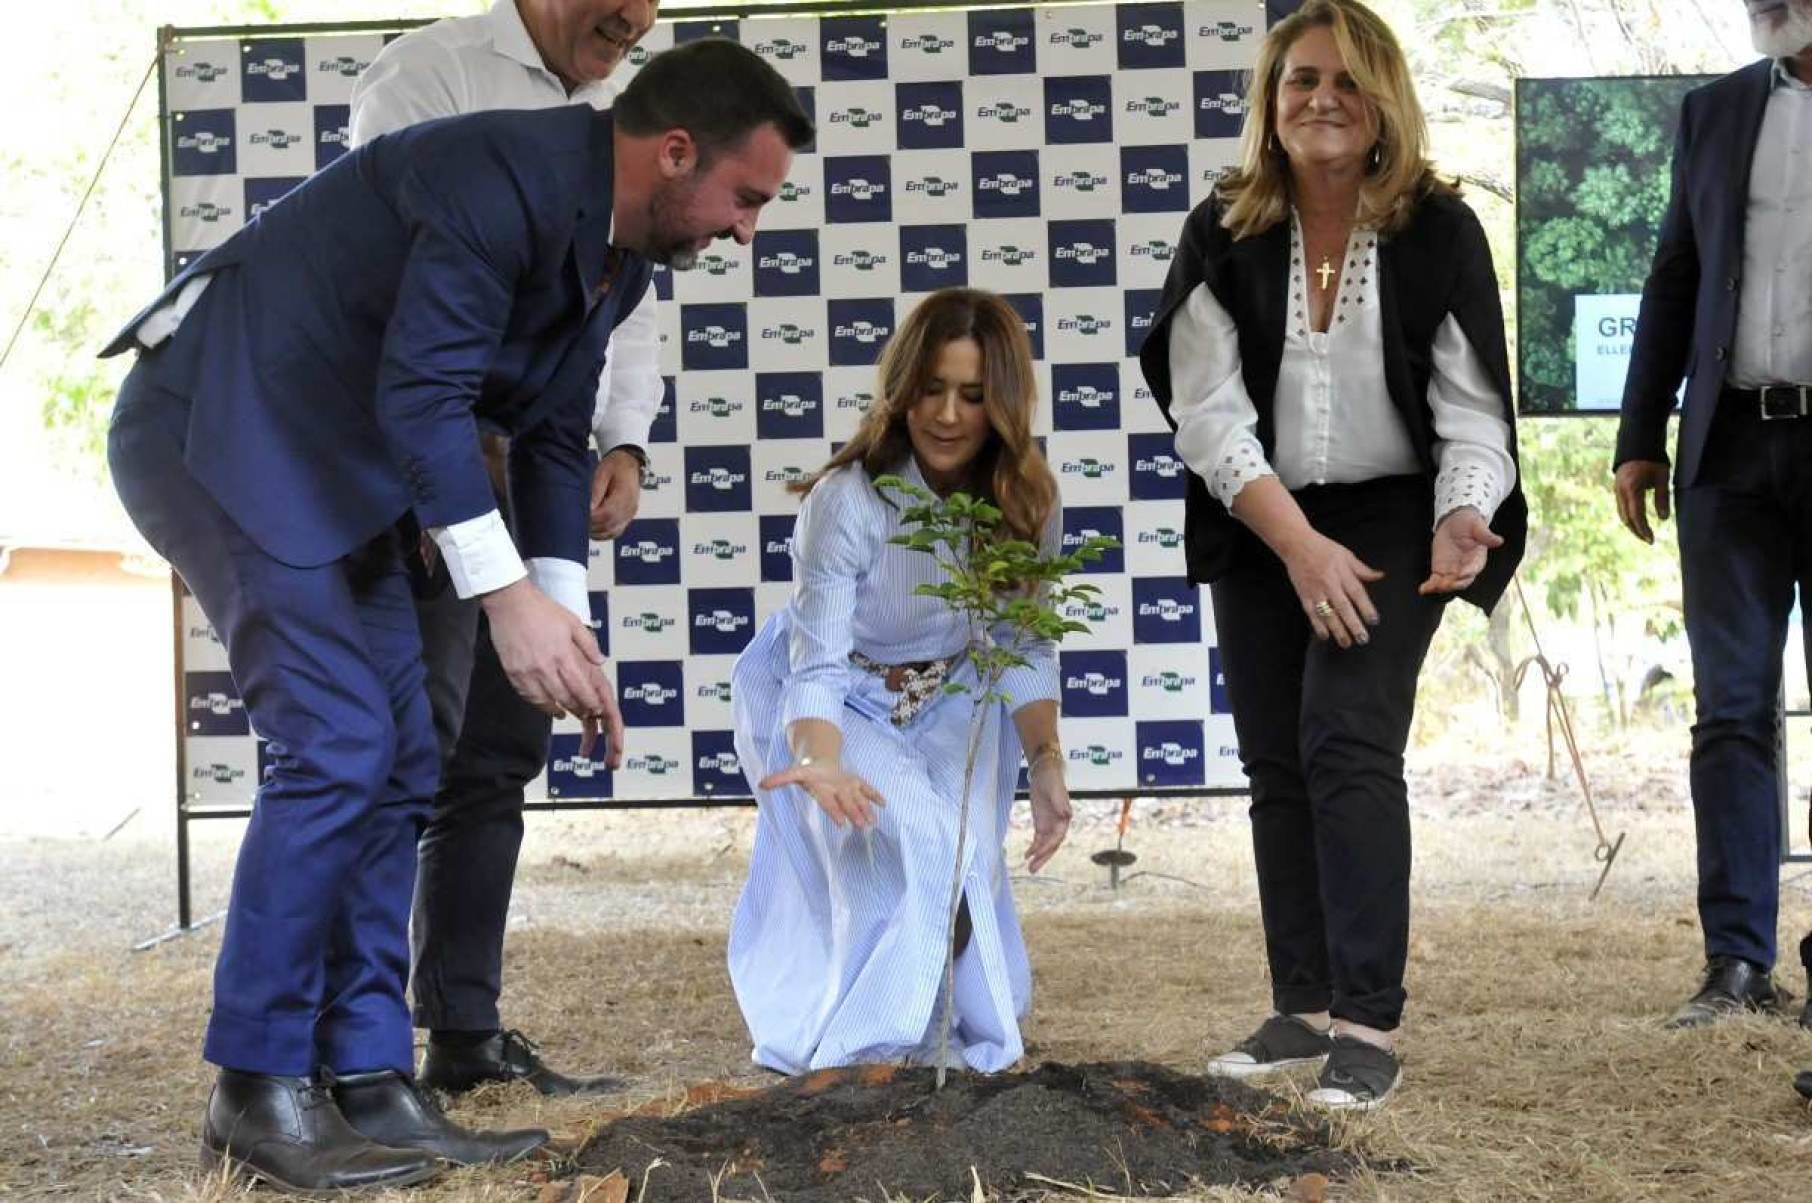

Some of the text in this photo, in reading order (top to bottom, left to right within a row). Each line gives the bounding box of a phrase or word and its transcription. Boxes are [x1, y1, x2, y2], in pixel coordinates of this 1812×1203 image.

[1050, 30, 1102, 45] Embrapa
[1125, 27, 1177, 42] Embrapa
[1200, 24, 1252, 39] Embrapa
[828, 39, 880, 54] Embrapa
[902, 36, 954, 51] Embrapa
[976, 33, 1028, 48] Embrapa
[754, 42, 806, 57] Embrapa
[978, 104, 1030, 119] Embrapa
[1052, 102, 1104, 117] Embrapa
[1127, 99, 1179, 114] Embrapa
[830, 110, 882, 125] Embrapa
[904, 107, 956, 122] Embrapa
[980, 176, 1032, 191] Embrapa
[1054, 173, 1106, 188] Embrapa
[1129, 171, 1181, 186] Embrapa
[832, 181, 884, 196] Embrapa
[905, 179, 957, 194] Embrapa
[982, 247, 1034, 262] Embrapa
[1056, 245, 1108, 260] Embrapa
[1131, 242, 1180, 257] Embrap
[760, 255, 812, 270] Embrapa
[834, 252, 886, 267] Embrapa
[907, 250, 959, 265] Embrapa
[835, 324, 887, 339] Embrapa
[1058, 317, 1110, 332] Embrapa
[689, 328, 741, 343] Embrapa
[762, 326, 814, 341] Embrapa
[1060, 388, 1112, 403] Embrapa
[690, 399, 742, 414] Embrapa
[764, 397, 816, 412] Embrapa
[1062, 460, 1114, 475] Embrapa
[692, 470, 744, 485] Embrapa
[1139, 530, 1184, 545] Embrap
[621, 543, 673, 558] Embrapa
[694, 541, 746, 556] Embrapa
[1066, 604, 1118, 619] Embrapa
[1141, 602, 1193, 617] Embrapa
[623, 614, 675, 629] Embrapa
[696, 613, 748, 628] Embrapa
[1068, 675, 1120, 690] Embrapa
[1143, 674, 1195, 689] Embrapa
[625, 685, 677, 700] Embrapa
[1070, 747, 1122, 762] Embrapa
[1145, 746, 1197, 761] Embrapa
[554, 758, 606, 773] Embrapa
[627, 756, 679, 771] Embrapa
